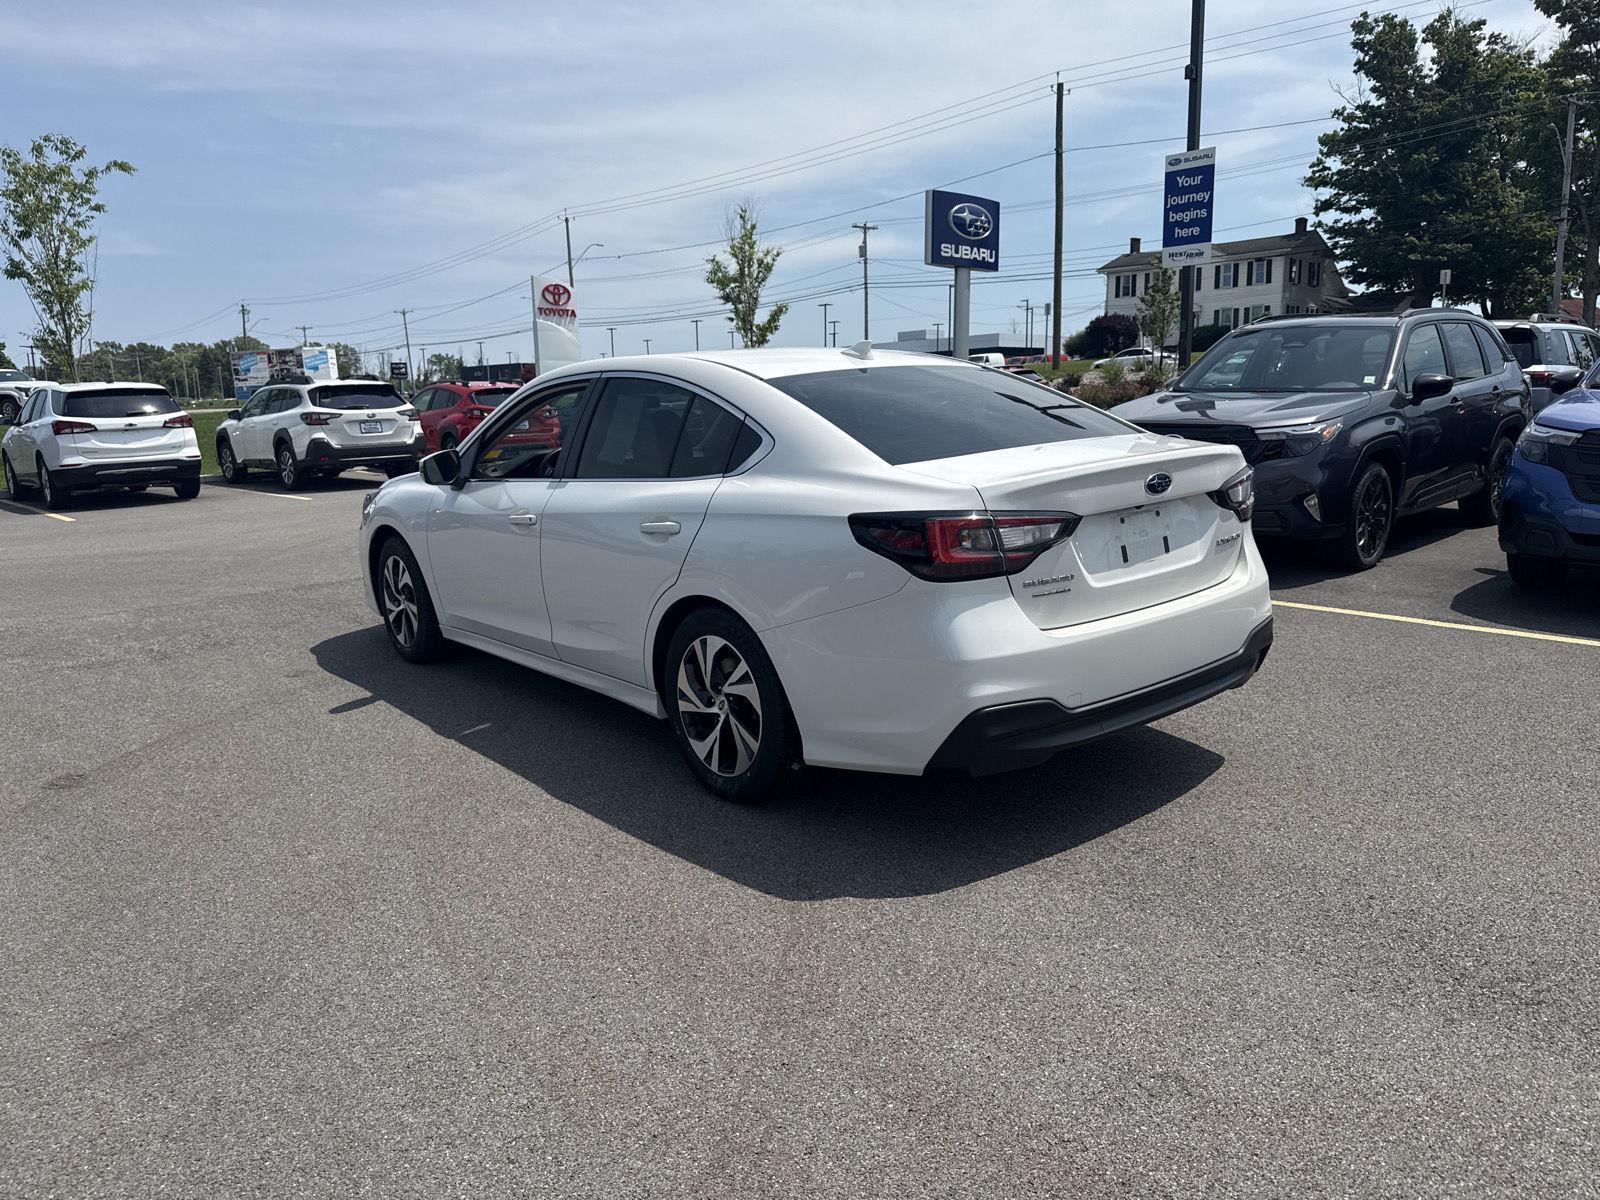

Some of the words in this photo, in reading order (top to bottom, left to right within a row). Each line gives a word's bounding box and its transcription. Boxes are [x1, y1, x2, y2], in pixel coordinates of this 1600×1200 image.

[1183, 153, 1213, 163] SUBARU
[1176, 175, 1203, 187] Your
[1166, 191, 1211, 208] journey
[1169, 208, 1208, 222] begins
[1174, 226, 1200, 238] here
[940, 243, 996, 263] SUBARU
[537, 306, 577, 318] TOYOTA
